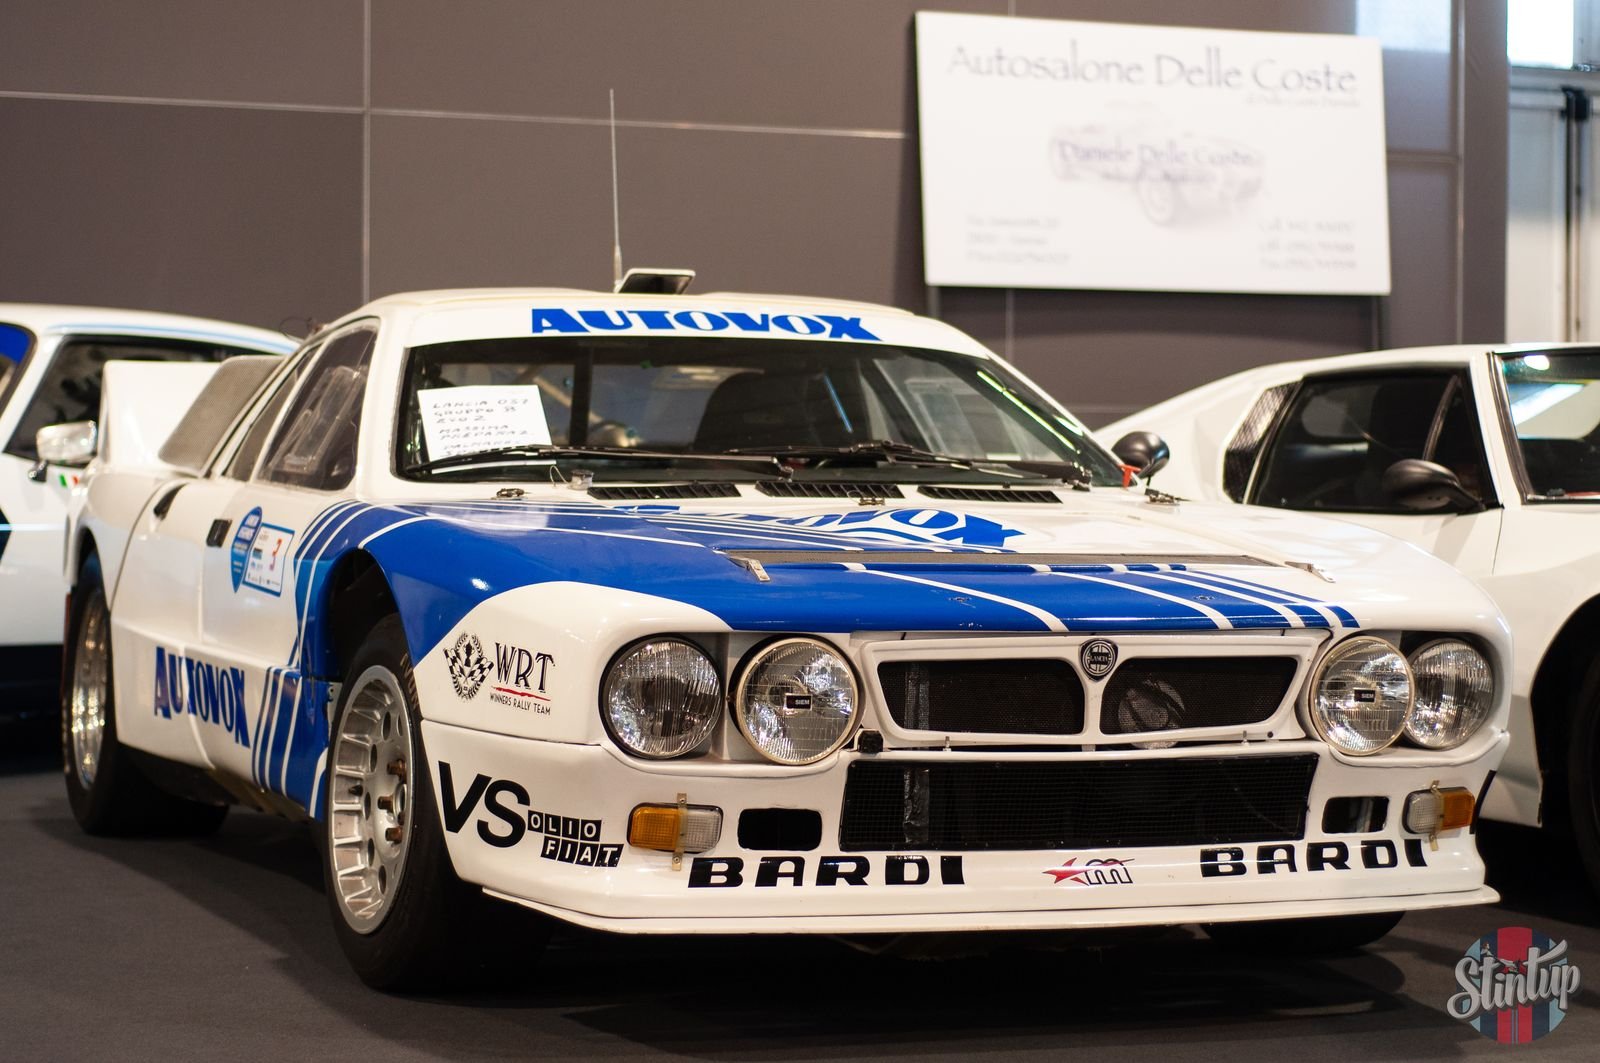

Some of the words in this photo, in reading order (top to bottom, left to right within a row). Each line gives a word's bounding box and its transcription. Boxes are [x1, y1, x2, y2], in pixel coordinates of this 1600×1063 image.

[947, 38, 1144, 84] Autosalone
[1155, 45, 1242, 90] Delle
[1252, 57, 1357, 94] Coste
[531, 308, 884, 342] AUTOVOX
[494, 642, 556, 693] WRT
[154, 646, 250, 748] AUTOVOX
[490, 693, 512, 707] WINNERS
[513, 699, 531, 711] RALLY
[533, 703, 551, 715] TEAM
[438, 760, 531, 848] VS
[529, 812, 599, 839] OLIO
[543, 838, 620, 866] FIAT
[1200, 839, 1427, 877] BARDI
[688, 856, 965, 888] BARDI
